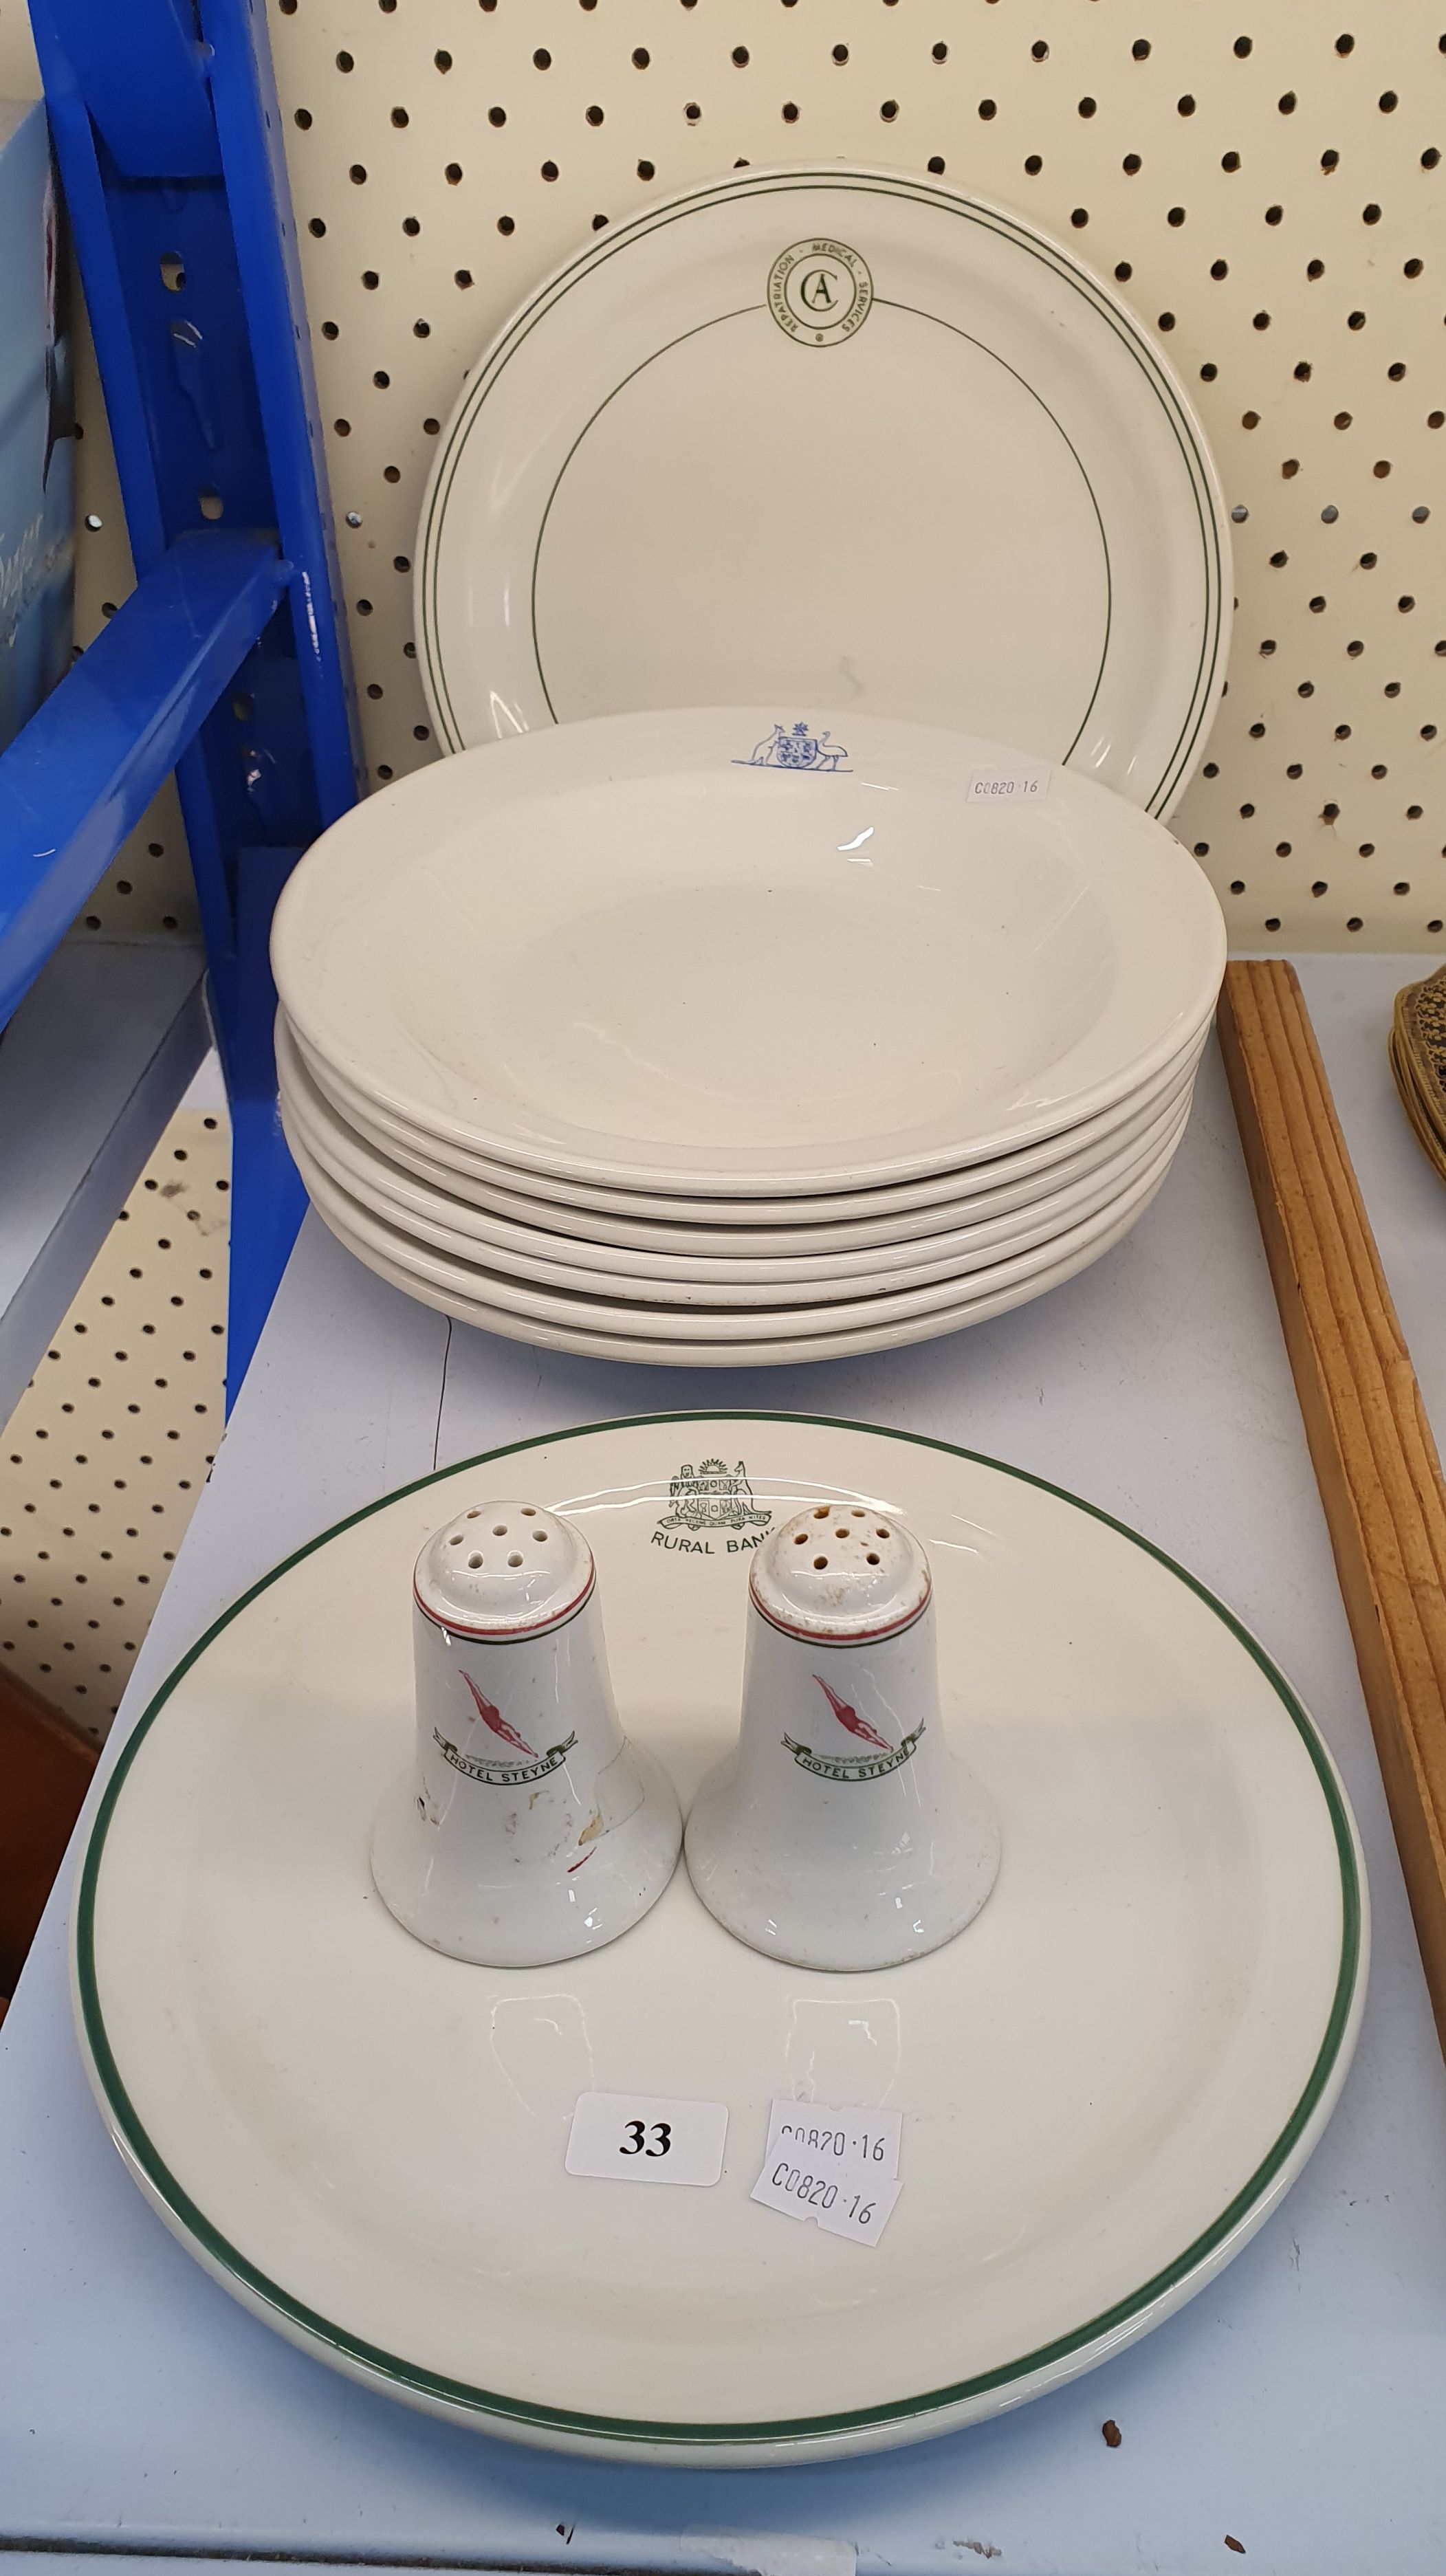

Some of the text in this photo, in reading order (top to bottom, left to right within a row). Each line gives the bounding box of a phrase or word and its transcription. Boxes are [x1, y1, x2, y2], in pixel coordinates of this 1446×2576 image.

[811, 243, 858, 268] MEDICAL
[842, 281, 869, 332] SERVICES
[650, 1531, 715, 1554] RURAL
[450, 1754, 558, 1782] HOTEL STEYNE
[802, 1748, 910, 1779] HOTEL STEYNE
[619, 2120, 672, 2157] 33
